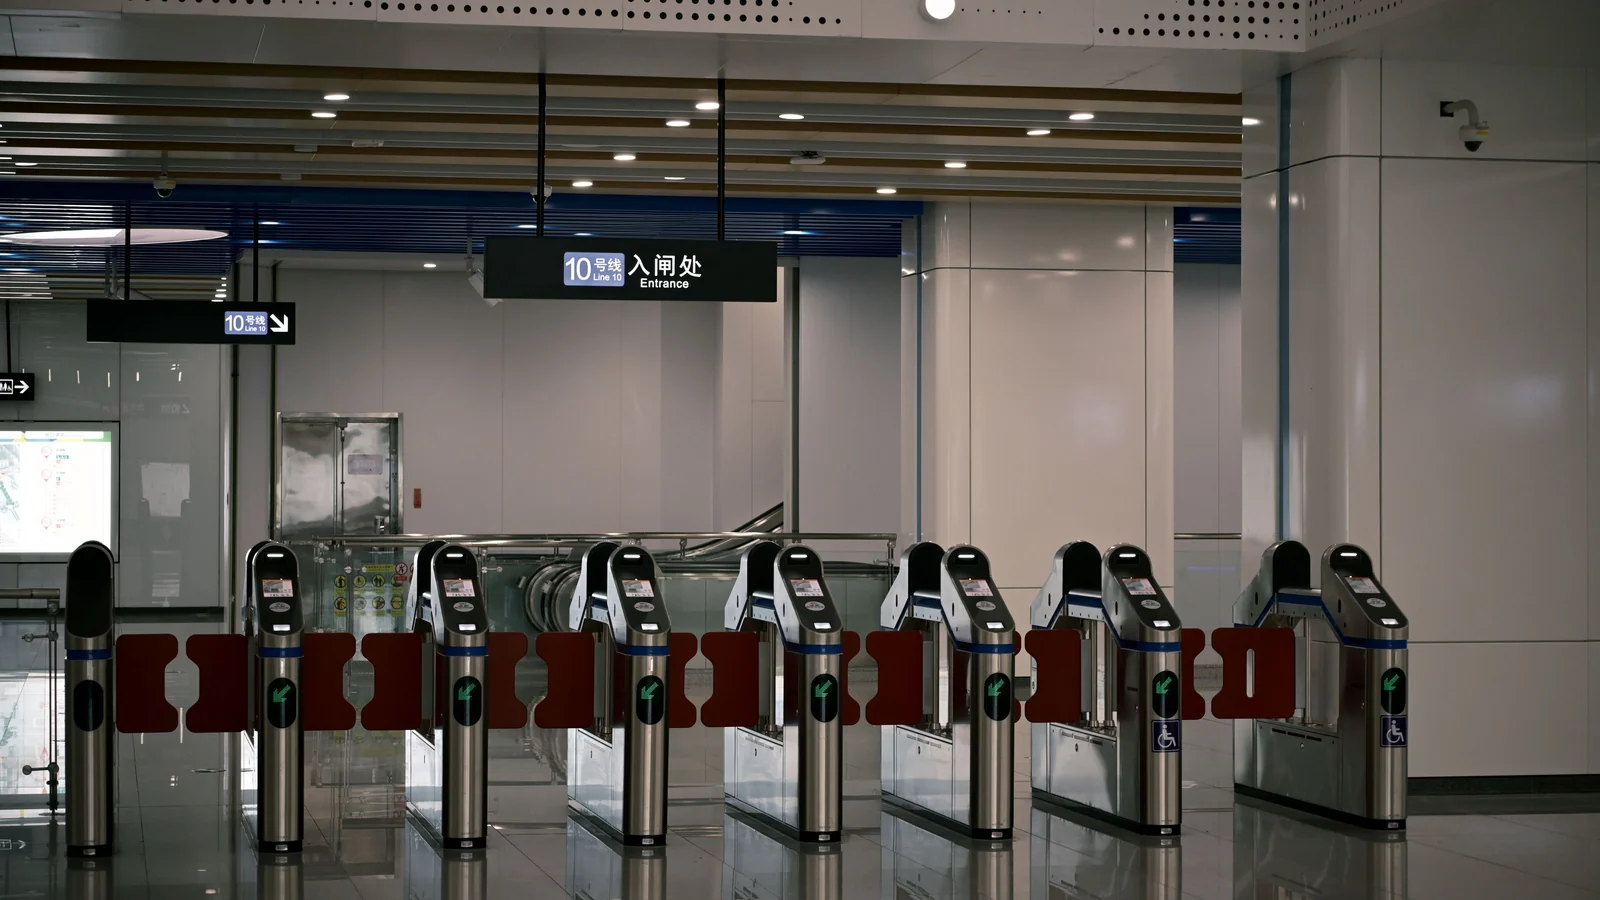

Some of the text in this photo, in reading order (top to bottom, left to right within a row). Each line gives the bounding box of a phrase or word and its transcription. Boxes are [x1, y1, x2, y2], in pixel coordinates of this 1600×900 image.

[627, 254, 702, 278] 入闸处
[593, 273, 610, 281] Line
[640, 278, 689, 289] Entrance
